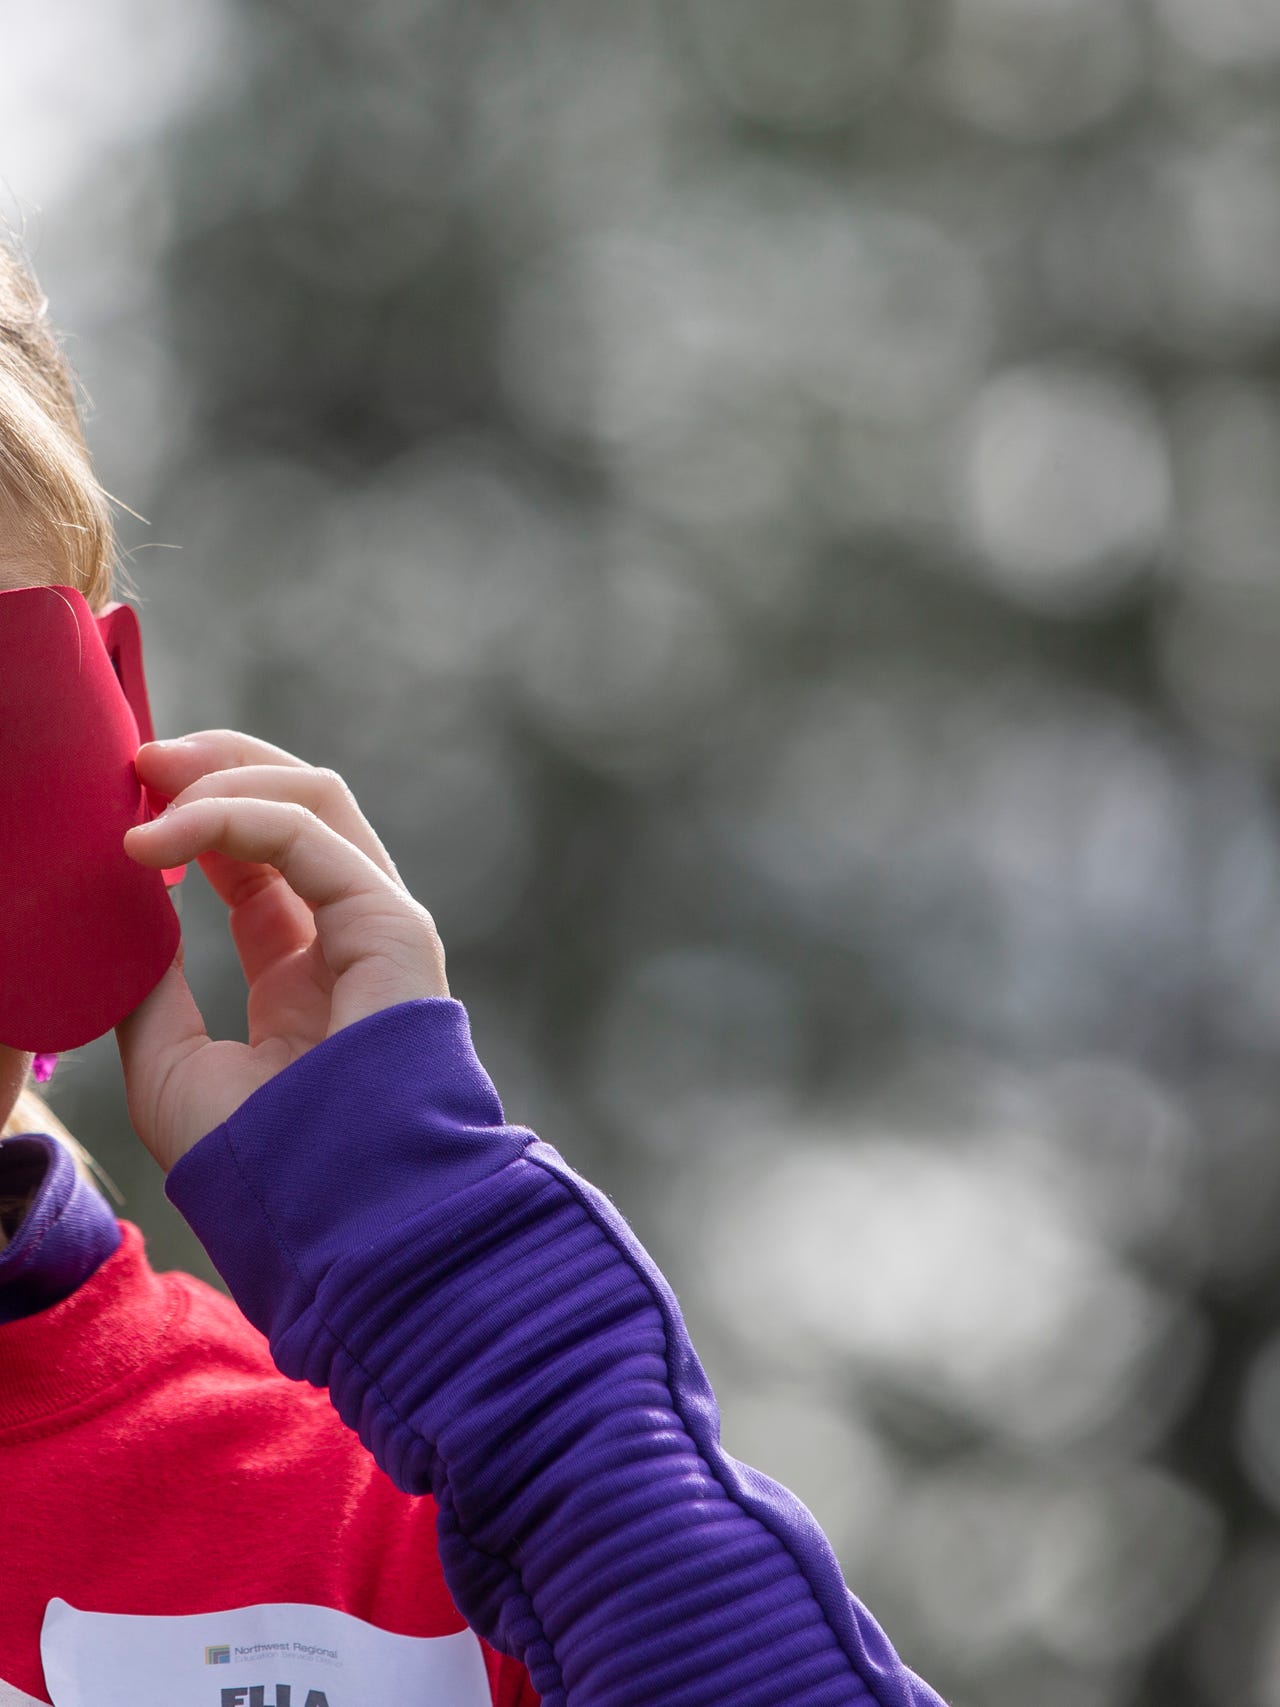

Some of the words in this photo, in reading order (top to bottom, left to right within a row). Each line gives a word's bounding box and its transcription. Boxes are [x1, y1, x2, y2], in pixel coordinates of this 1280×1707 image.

[234, 1643, 290, 1655] Northwest
[293, 1642, 338, 1658] Regional
[234, 1651, 279, 1663] Education
